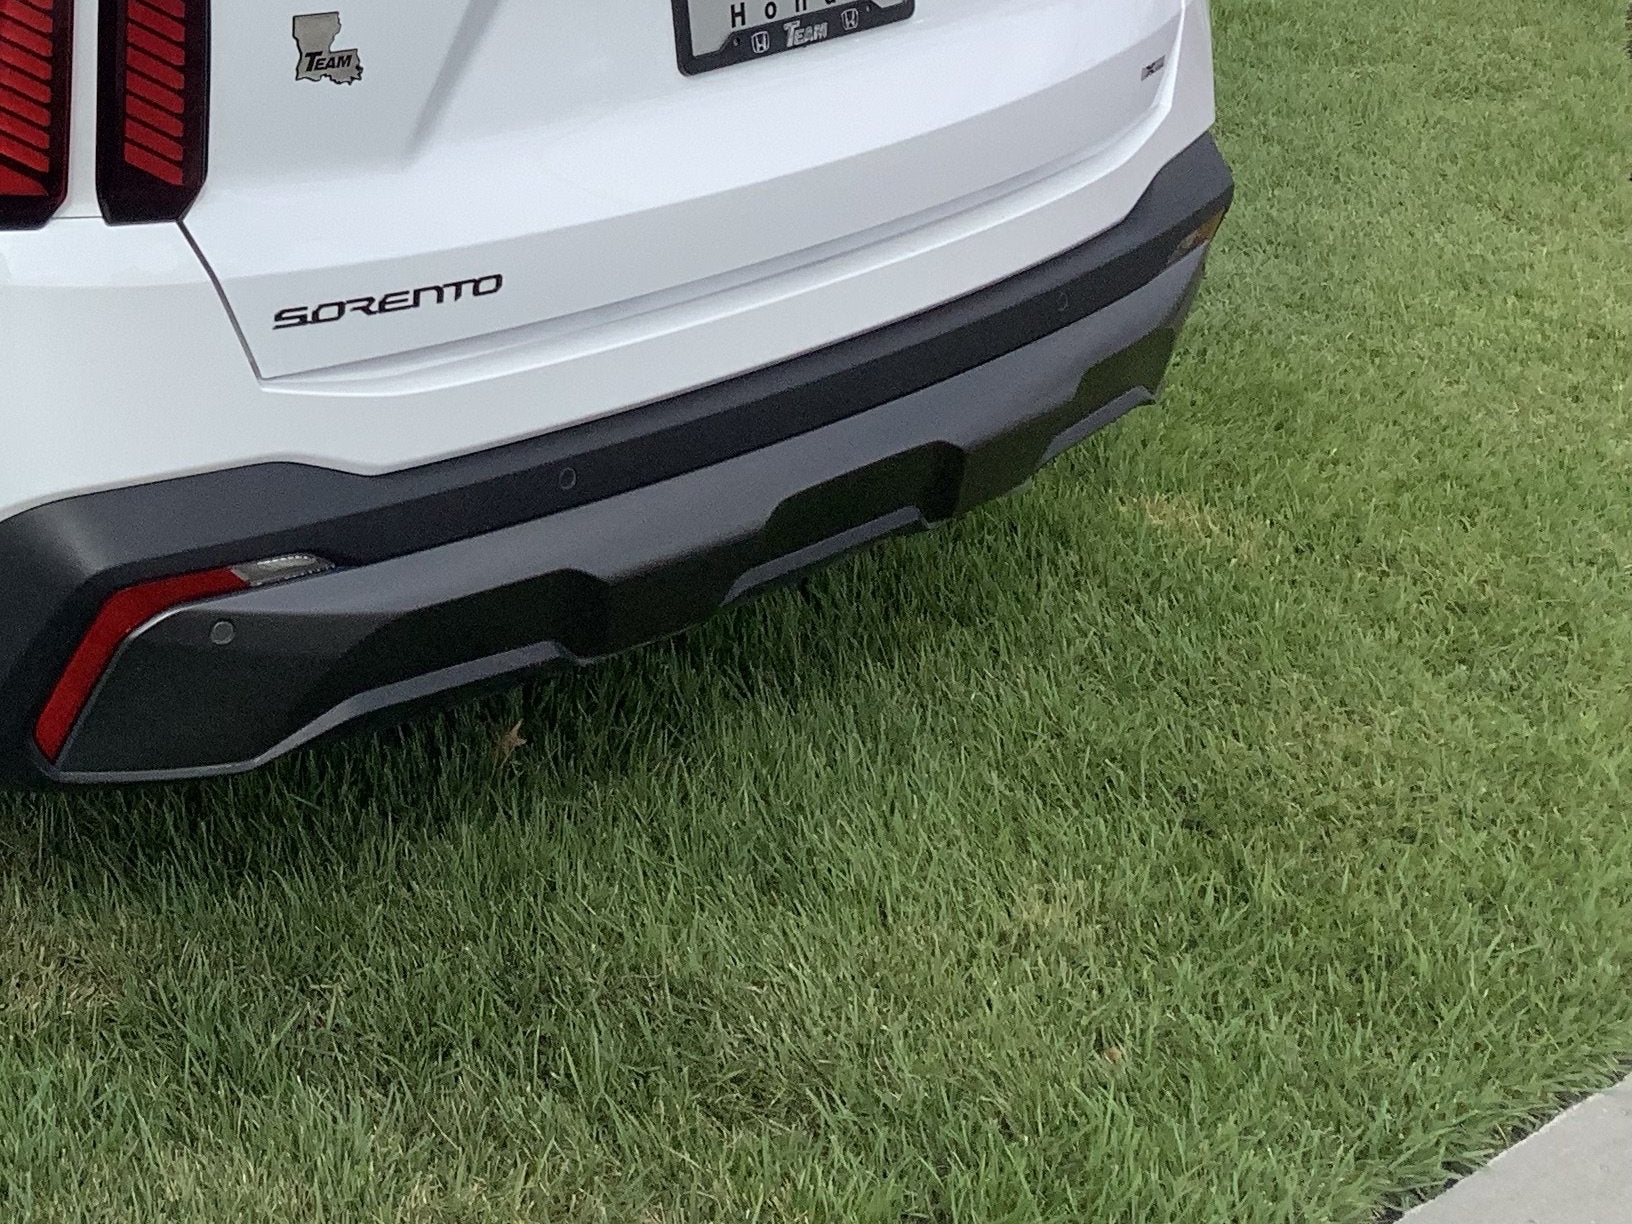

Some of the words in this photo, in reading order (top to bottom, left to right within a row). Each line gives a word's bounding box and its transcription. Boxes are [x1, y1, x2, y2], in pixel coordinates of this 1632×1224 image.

[783, 19, 829, 48] TEAM
[304, 50, 353, 72] TEAM
[272, 273, 503, 330] SORENTO
